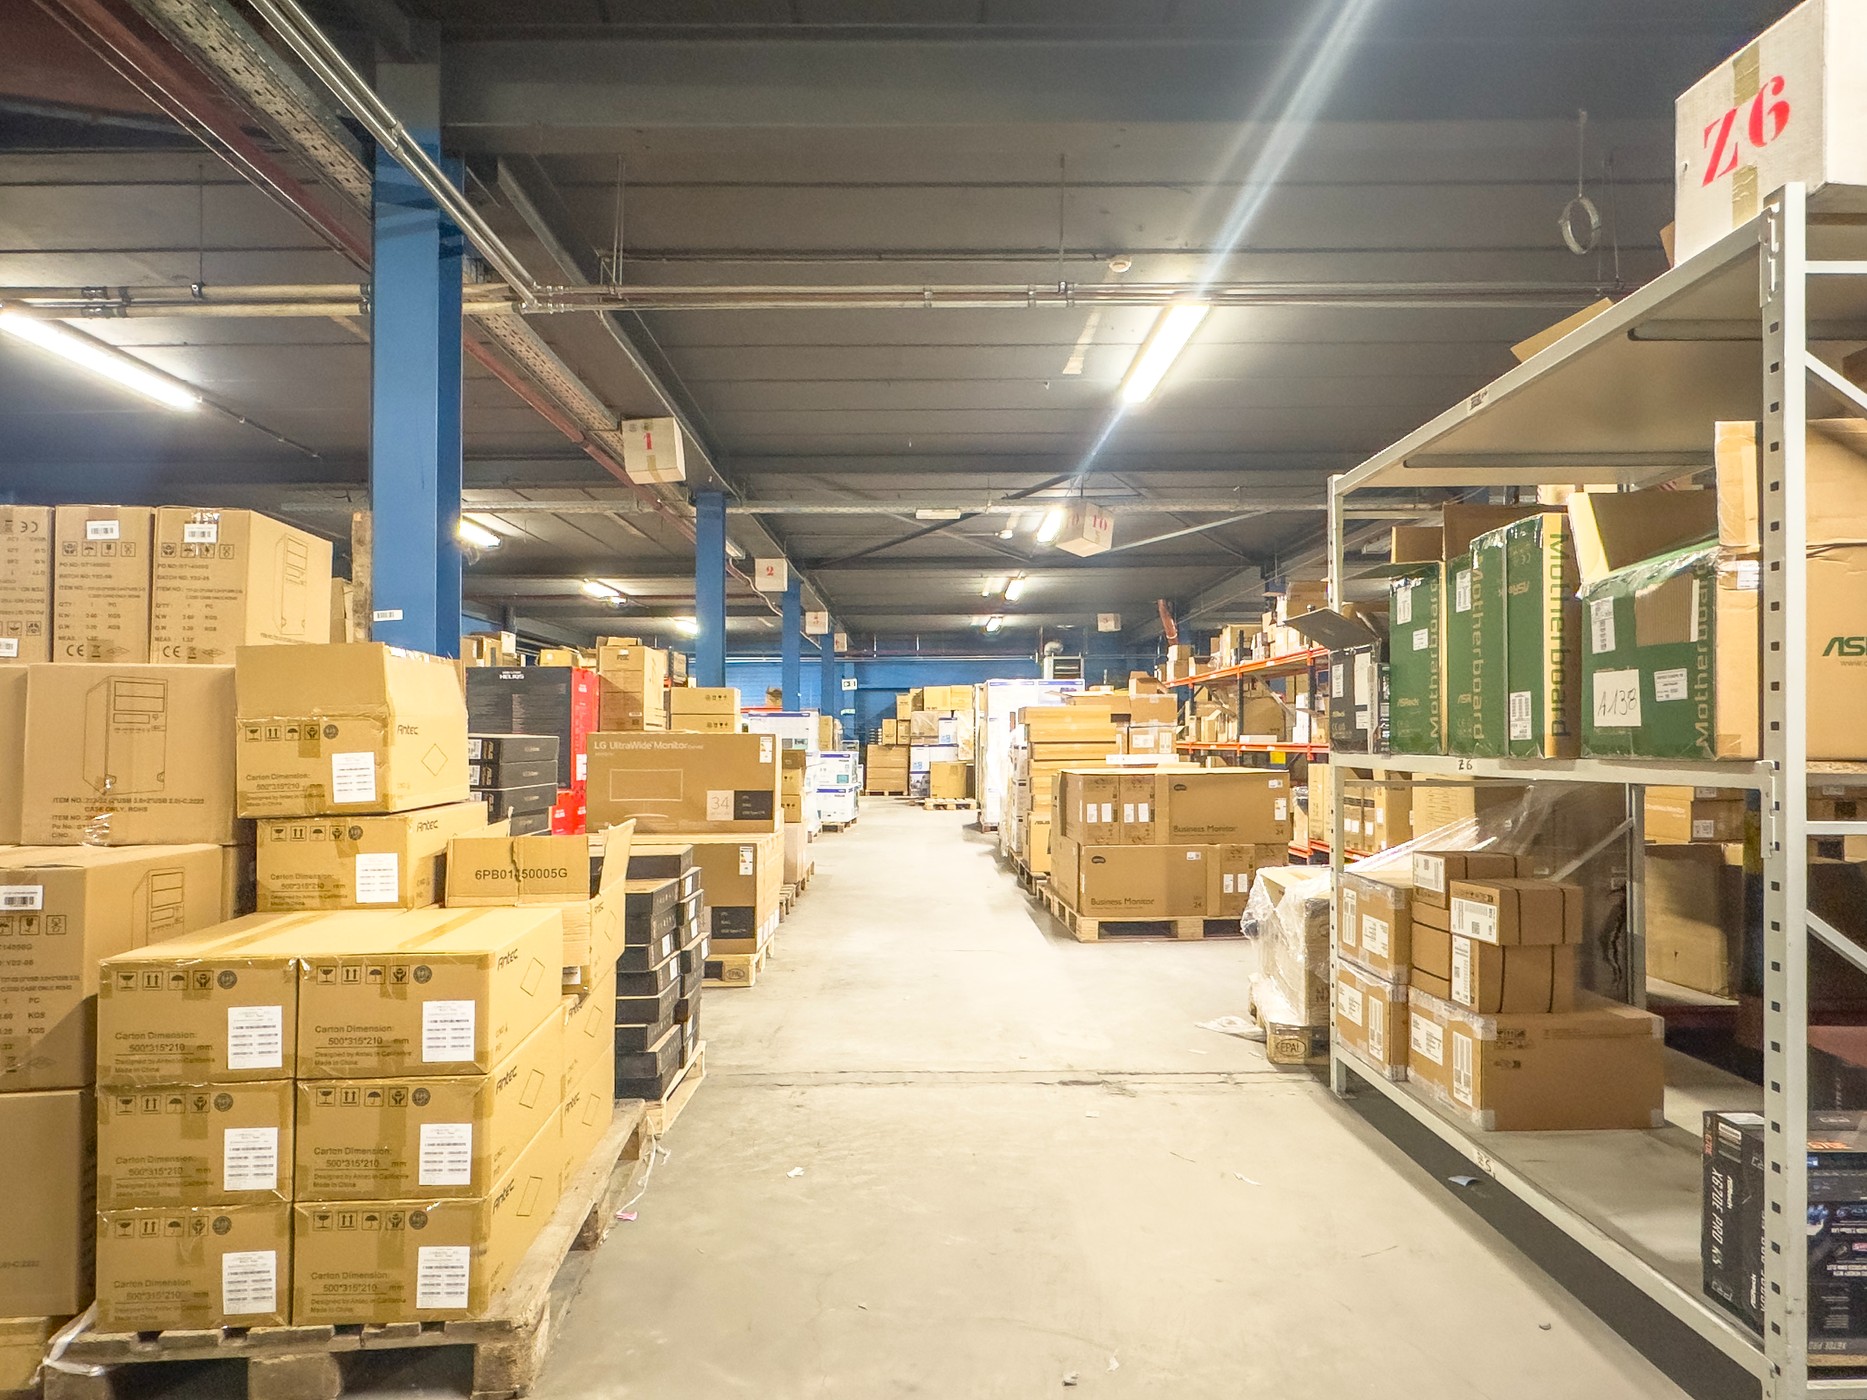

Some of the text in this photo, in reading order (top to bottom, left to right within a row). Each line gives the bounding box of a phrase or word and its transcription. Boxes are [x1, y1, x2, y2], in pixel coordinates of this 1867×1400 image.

[1702, 75, 1790, 187] Z6
[643, 432, 652, 450] 1
[766, 566, 775, 577] 2
[1550, 533, 1572, 738] Motherboard
[1822, 636, 1867, 656] AS
[594, 741, 607, 749] LG
[654, 741, 688, 750] Monitor
[711, 796, 730, 810] 34
[315, 1025, 344, 1033] Carton
[1280, 1042, 1301, 1053] EPAL
[314, 1147, 343, 1155] Carton
[1712, 1166, 1724, 1214] X670E
[1712, 1211, 1724, 1245] PRO
[311, 1272, 340, 1280] Carton
